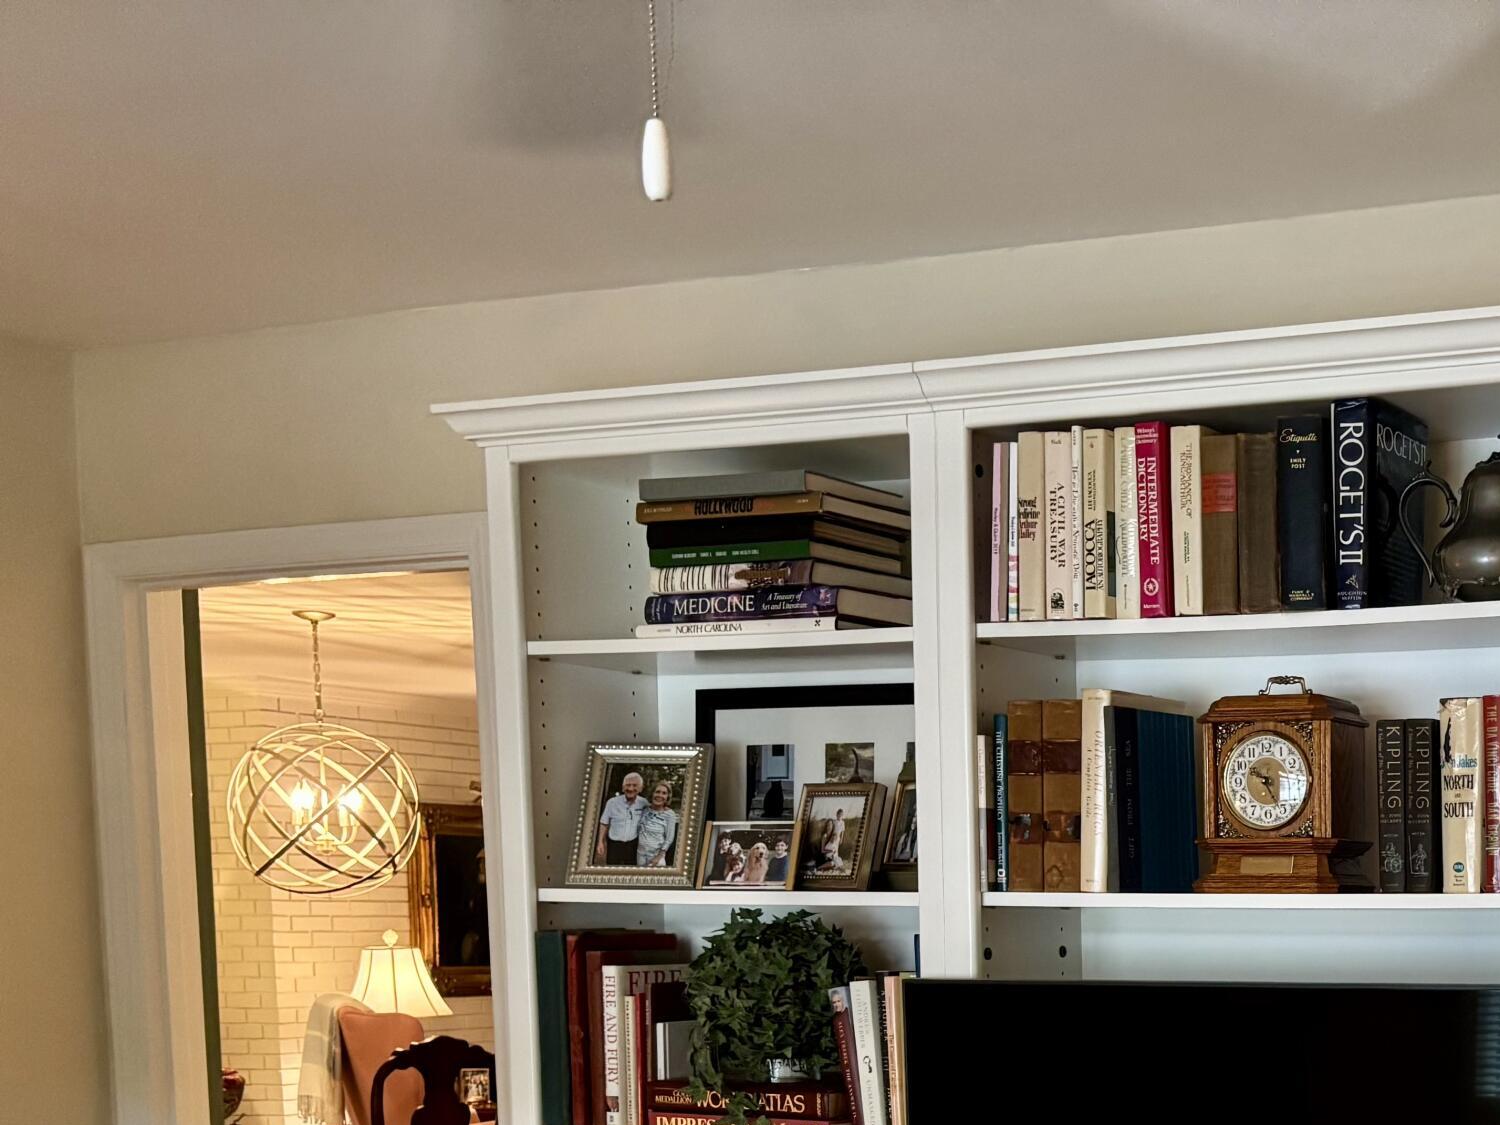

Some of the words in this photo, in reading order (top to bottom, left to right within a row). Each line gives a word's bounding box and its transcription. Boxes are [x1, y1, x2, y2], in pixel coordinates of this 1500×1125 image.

[1279, 428, 1318, 443] Etiquette
[1377, 423, 1420, 464] ROGET'S
[1057, 482, 1065, 491] A
[1339, 422, 1364, 545] ROGET'S
[694, 497, 754, 516] HOLLYWOOD
[1137, 458, 1148, 542] DICTIONARY
[1057, 495, 1065, 534] CIVIL
[1147, 457, 1160, 565] INTERMEDIATE
[1058, 539, 1066, 568] WAR
[1085, 520, 1096, 590] IACOCCA
[1339, 550, 1363, 565] II
[674, 595, 754, 616] MEDICINE
[676, 625, 703, 634] NORTH
[704, 624, 743, 633] CAROLINA
[1487, 705, 1497, 722] THE
[1487, 727, 1497, 740] DA
[1248, 748, 1255, 758] 11
[1261, 742, 1272, 753] 12
[1487, 741, 1499, 768] VINCI
[1237, 761, 1247, 771] 10
[1288, 759, 1296, 768] 2
[1386, 727, 1401, 808] KIPLING
[1416, 727, 1429, 808] KIPLING
[1457, 755, 1477, 768] Jakes
[1234, 777, 1242, 787] 9
[1444, 774, 1474, 790] NORTH
[1240, 793, 1247, 803] 8
[1250, 805, 1257, 816] 7
[1264, 809, 1272, 819] 6
[1444, 802, 1474, 818] SOUTH
[1487, 802, 1499, 820] DAN
[605, 975, 616, 1008] FIRE
[606, 1013, 618, 1045] AND
[606, 1048, 620, 1086] FURY
[655, 1095, 692, 1104] MEDALLION
[759, 1093, 805, 1112] ATLAS
